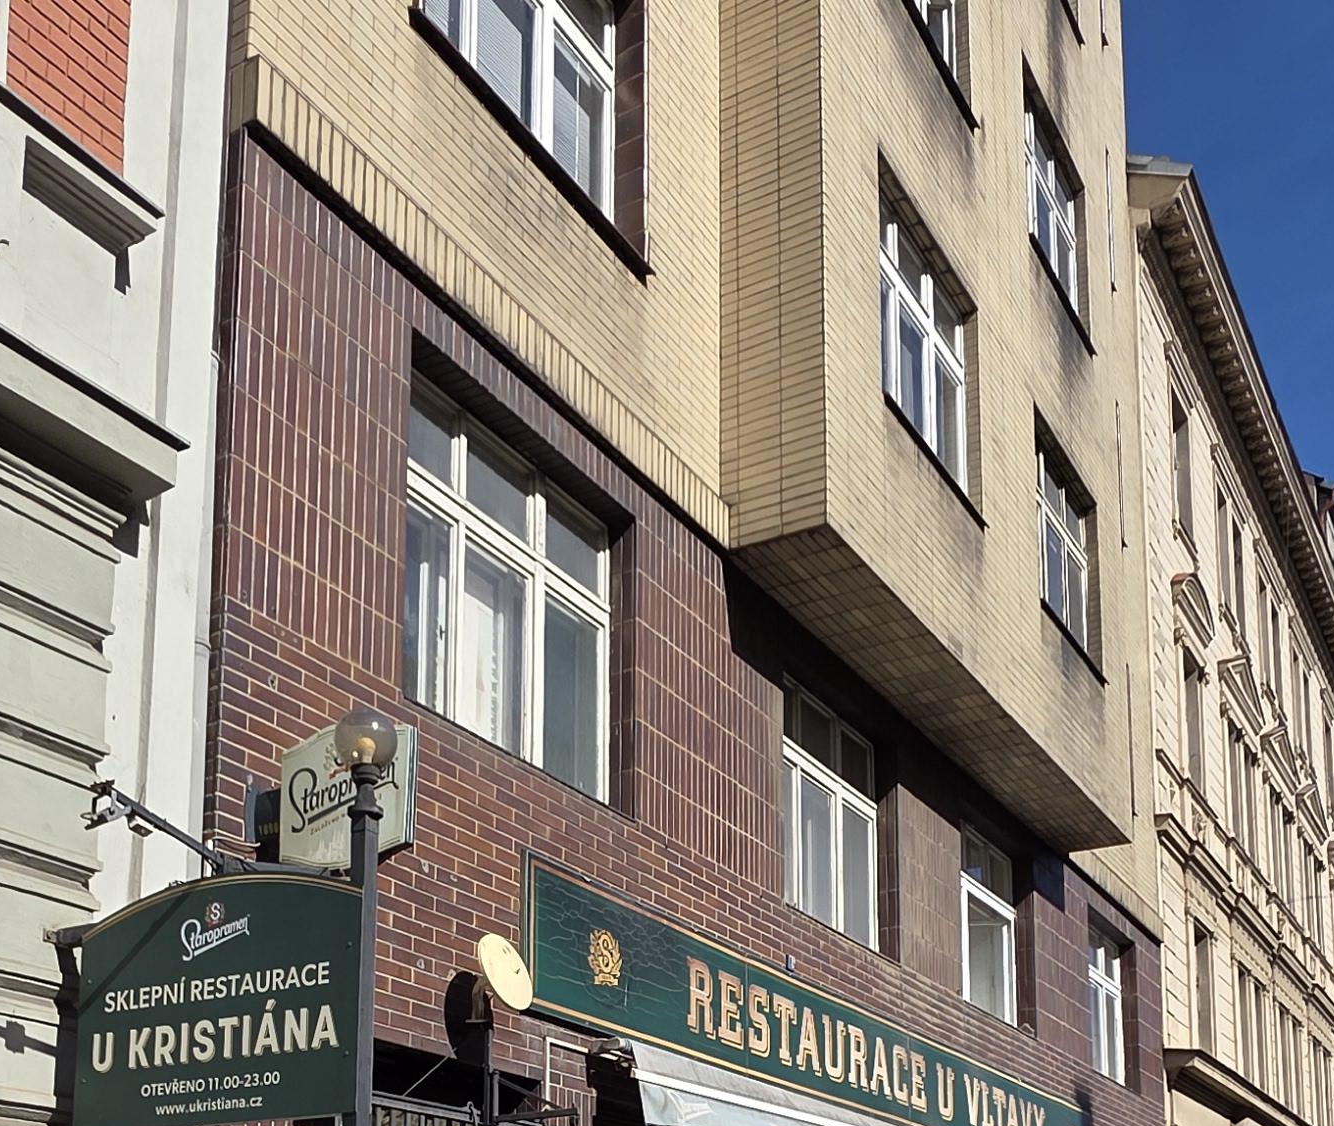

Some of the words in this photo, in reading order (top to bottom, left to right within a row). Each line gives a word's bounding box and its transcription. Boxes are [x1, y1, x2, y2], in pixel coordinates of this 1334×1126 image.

[180, 914, 250, 962] Staropramen
[104, 976, 185, 1014] SKLEPNÍ
[190, 962, 330, 1002] RESTAURACE
[91, 1032, 115, 1074] U
[128, 999, 339, 1070] KRISTIÁNA
[686, 955, 929, 1113] RESTAURACE
[935, 1062, 955, 1122] U
[141, 1077, 205, 1098] OTEVŘENO
[208, 1071, 281, 1092] 11.00-23.00
[155, 1095, 263, 1116] www.ukristiana.cz
